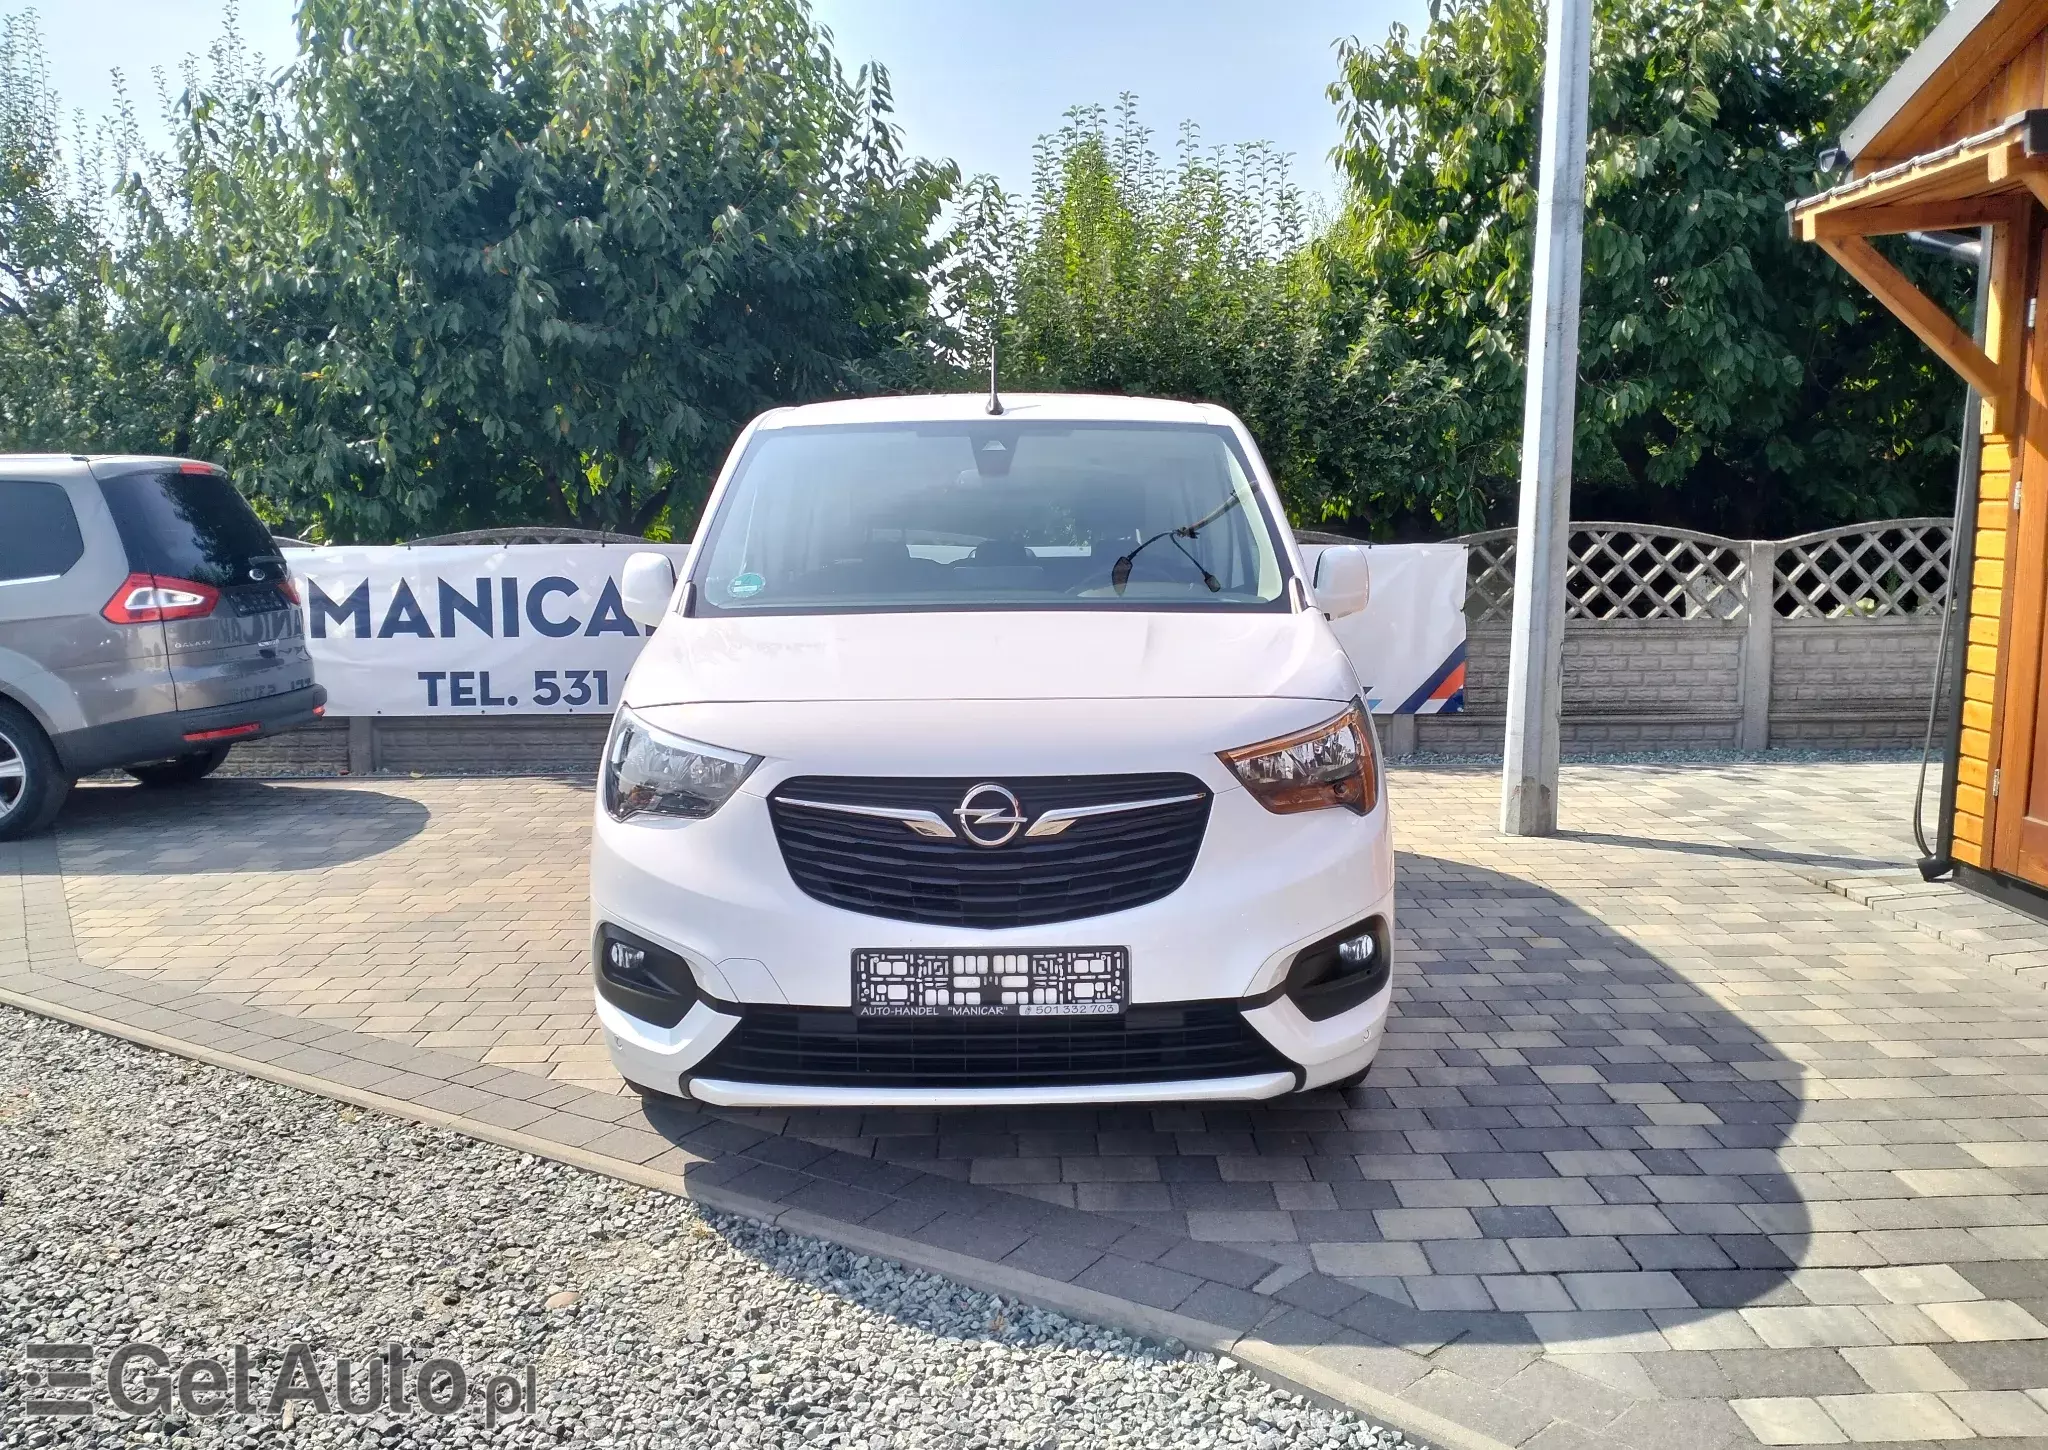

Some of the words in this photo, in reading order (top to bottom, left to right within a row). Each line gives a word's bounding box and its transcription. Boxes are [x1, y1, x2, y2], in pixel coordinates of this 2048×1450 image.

[307, 576, 657, 638] MANICA
[175, 640, 211, 648] GALAXY
[418, 671, 517, 707] TEL.
[533, 670, 609, 706] 531
[860, 1006, 939, 1016] AUTO-HANDEL
[947, 1006, 1008, 1016] "MANICAR"
[1035, 1005, 1059, 1015] 501
[1062, 1005, 1087, 1015] 332
[1090, 1004, 1114, 1014] 703
